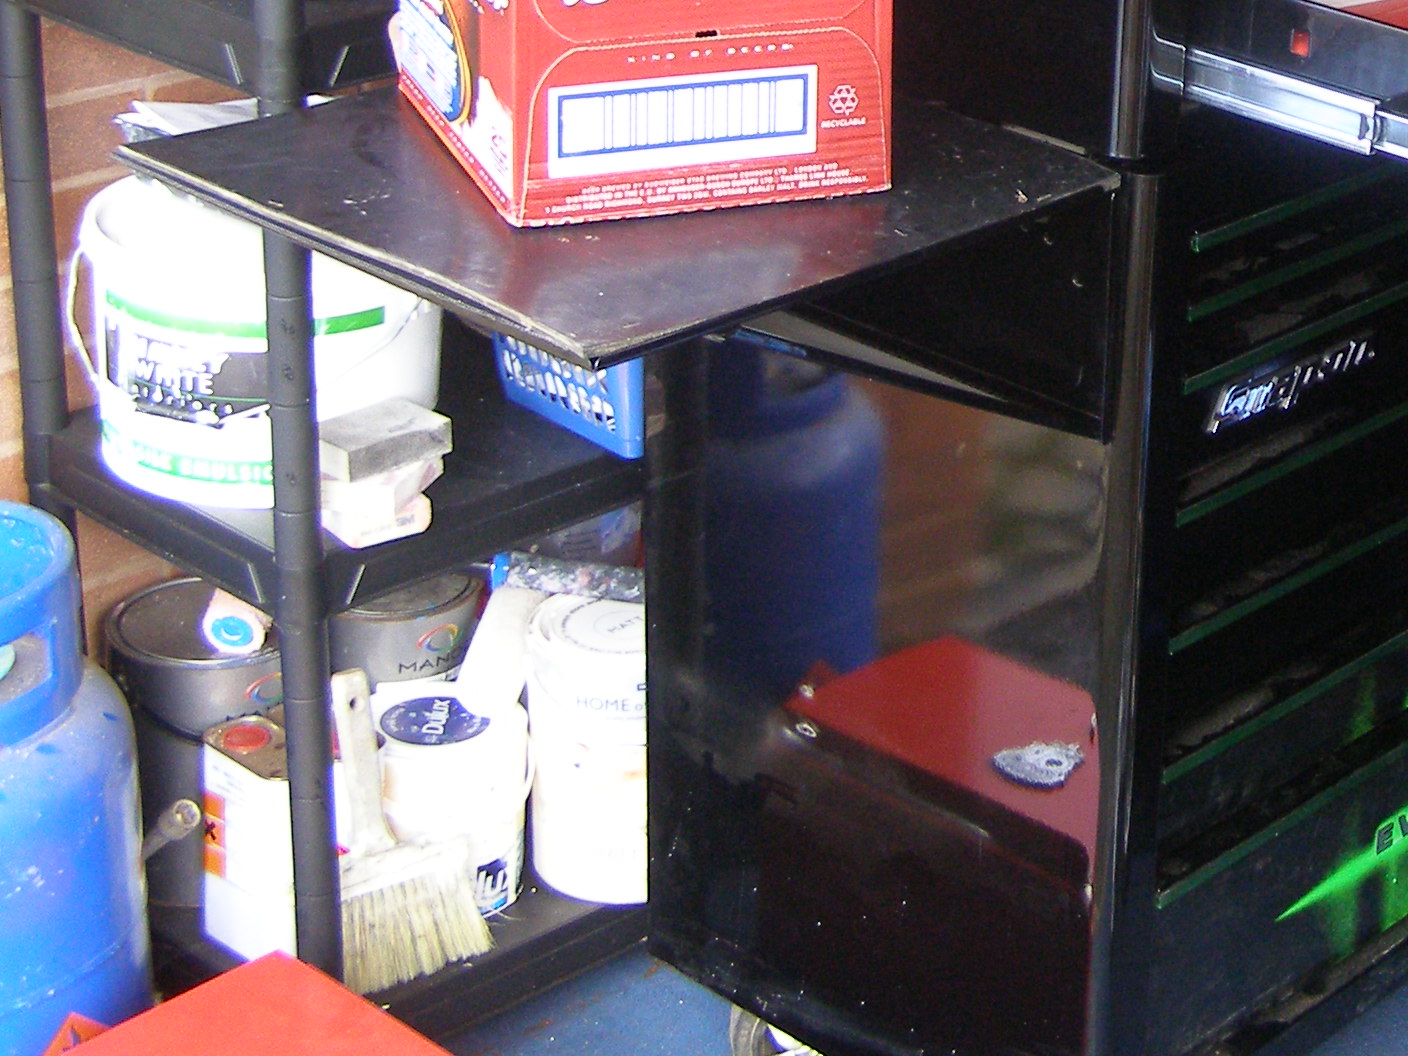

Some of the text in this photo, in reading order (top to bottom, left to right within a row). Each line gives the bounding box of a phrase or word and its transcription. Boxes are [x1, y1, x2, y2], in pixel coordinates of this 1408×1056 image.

[821, 116, 867, 129] RECYCLABLE
[576, 695, 631, 712] HOME
[421, 699, 452, 735] Dulux
